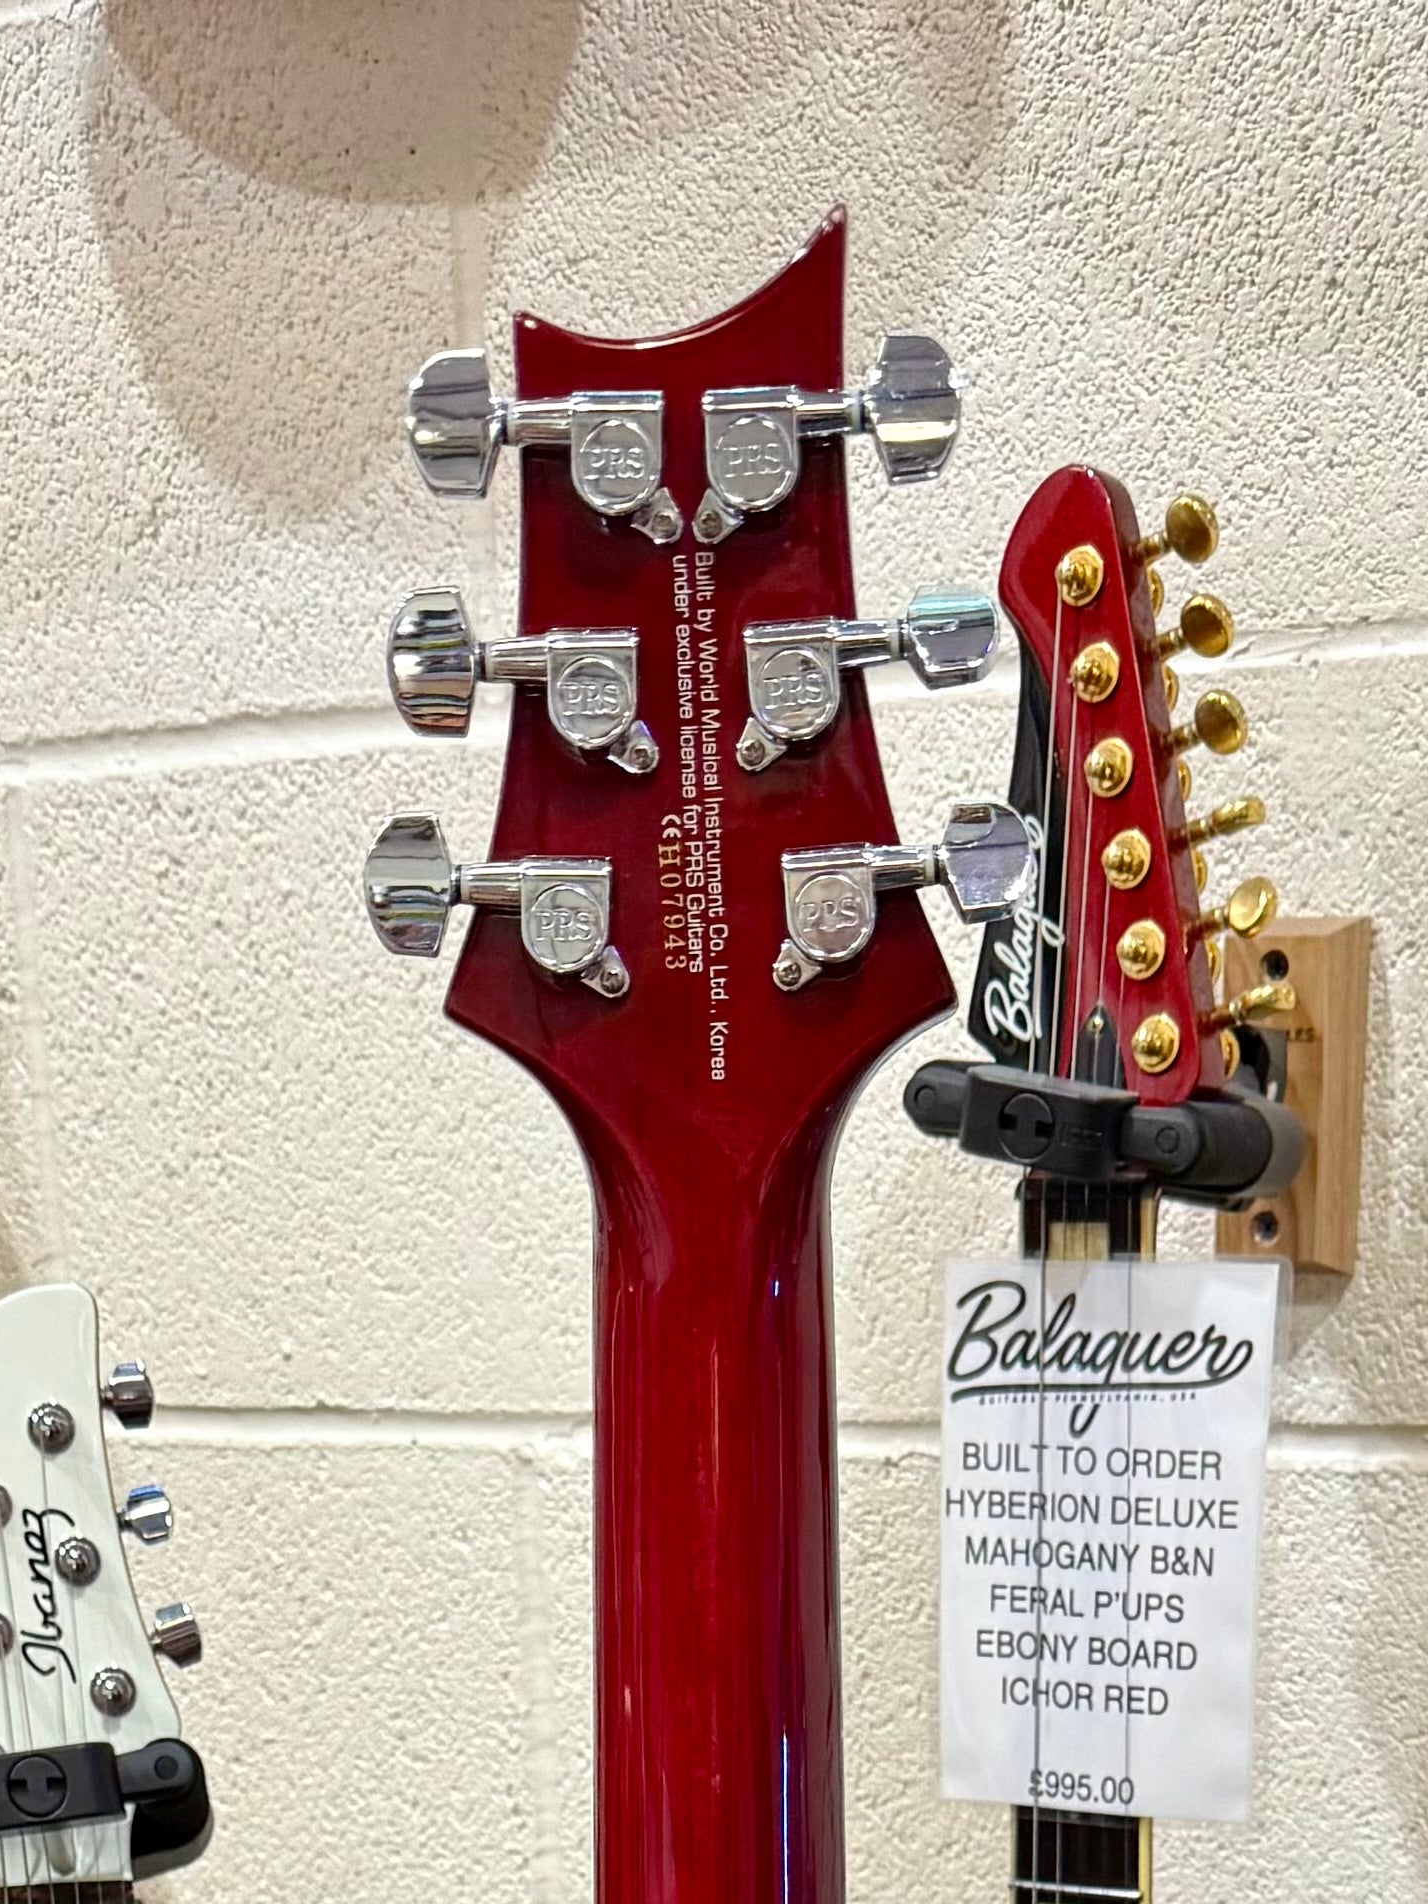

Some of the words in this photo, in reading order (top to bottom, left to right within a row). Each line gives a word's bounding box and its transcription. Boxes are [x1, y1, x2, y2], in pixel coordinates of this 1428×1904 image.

[583, 446, 646, 479] PRS
[723, 443, 781, 477] PRS
[672, 554, 695, 618] under
[695, 552, 716, 601] Built
[693, 609, 716, 632] by
[675, 624, 698, 719] exclusive
[698, 638, 720, 702] World
[762, 672, 824, 707] PRS
[562, 680, 621, 716] PRS
[679, 725, 699, 798] license
[701, 708, 723, 791] Musical
[682, 804, 702, 835] for
[684, 841, 705, 887] PRS
[703, 797, 726, 917] Instrument
[536, 908, 593, 943] PRS
[658, 843, 687, 969] H07943
[800, 897, 858, 932] PRS
[686, 893, 706, 973] Guitars
[984, 815, 1065, 1042] Balag
[709, 1022, 729, 1080] Korea
[947, 1279, 1253, 1439] Balaguer
[962, 1442, 1048, 1472] BUILT
[1058, 1446, 1095, 1476] TO
[1105, 1448, 1222, 1481] ORDER
[946, 1489, 1100, 1525] HYBERION
[1111, 1495, 1238, 1529] DELUXE
[964, 1536, 1139, 1573] MAHOGANY
[1151, 1545, 1214, 1577] B&N
[21, 1507, 76, 1683] Ibanez
[990, 1584, 1083, 1618] FERAL
[1094, 1590, 1184, 1623] P'UPS
[976, 1630, 1077, 1665] EBONY
[1088, 1637, 1197, 1671] BOARD
[1001, 1677, 1093, 1711] ICHOR
[1105, 1684, 1169, 1716] RED
[1028, 1770, 1134, 1804] £995.00
